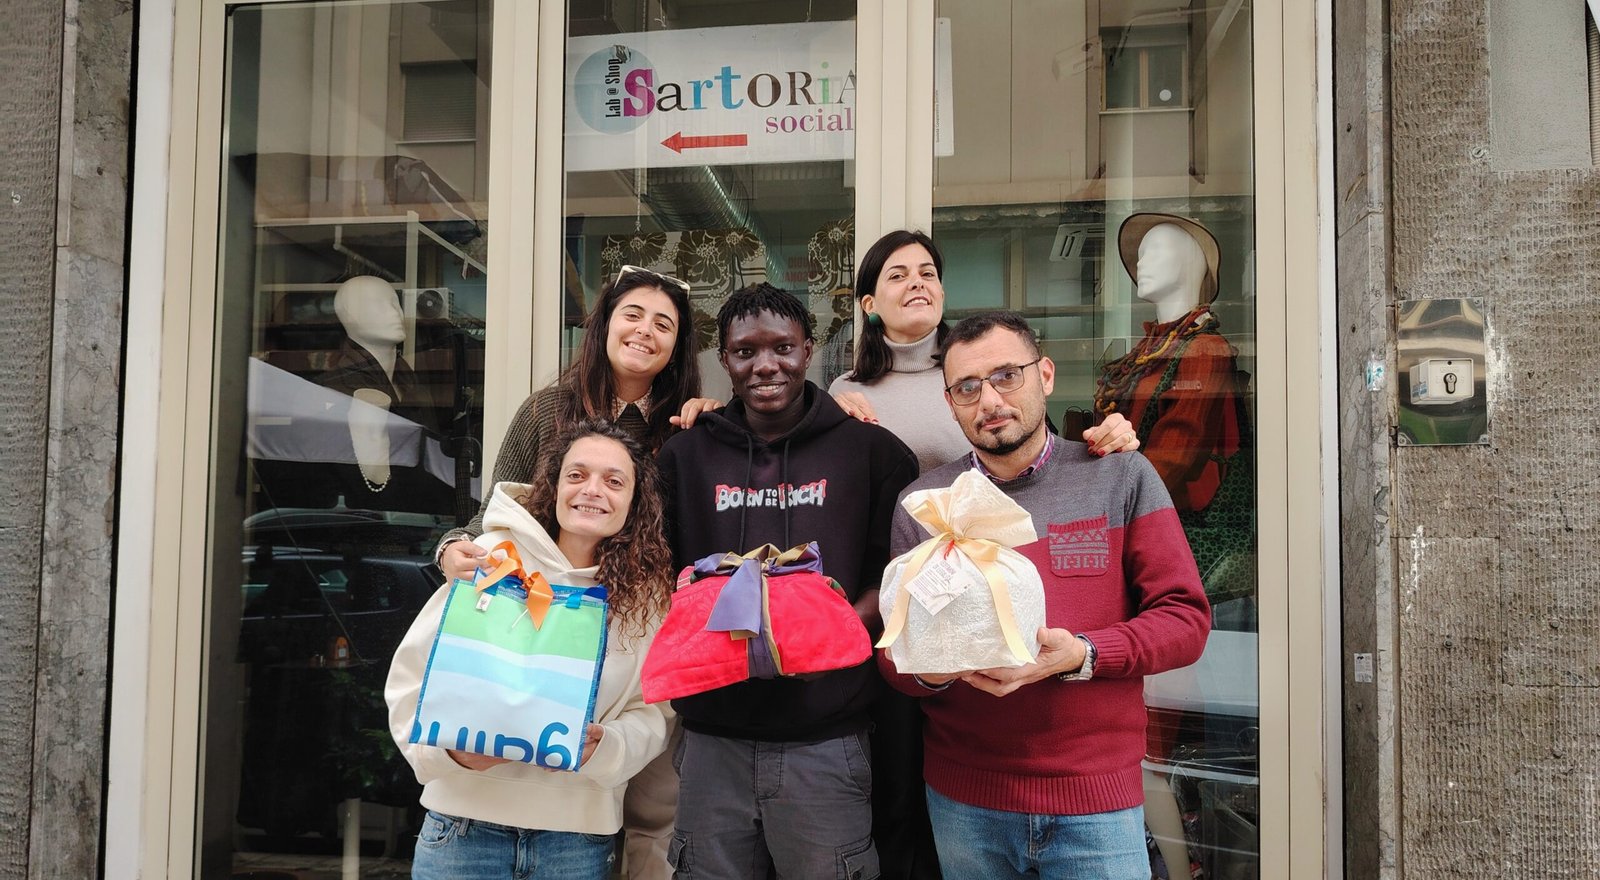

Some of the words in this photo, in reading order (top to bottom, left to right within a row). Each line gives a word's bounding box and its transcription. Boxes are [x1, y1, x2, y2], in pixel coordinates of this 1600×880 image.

[604, 58, 624, 85] Shop
[606, 87, 620, 96] @
[605, 98, 621, 118] Lab
[766, 488, 778, 498] TO
[765, 498, 778, 507] BE
